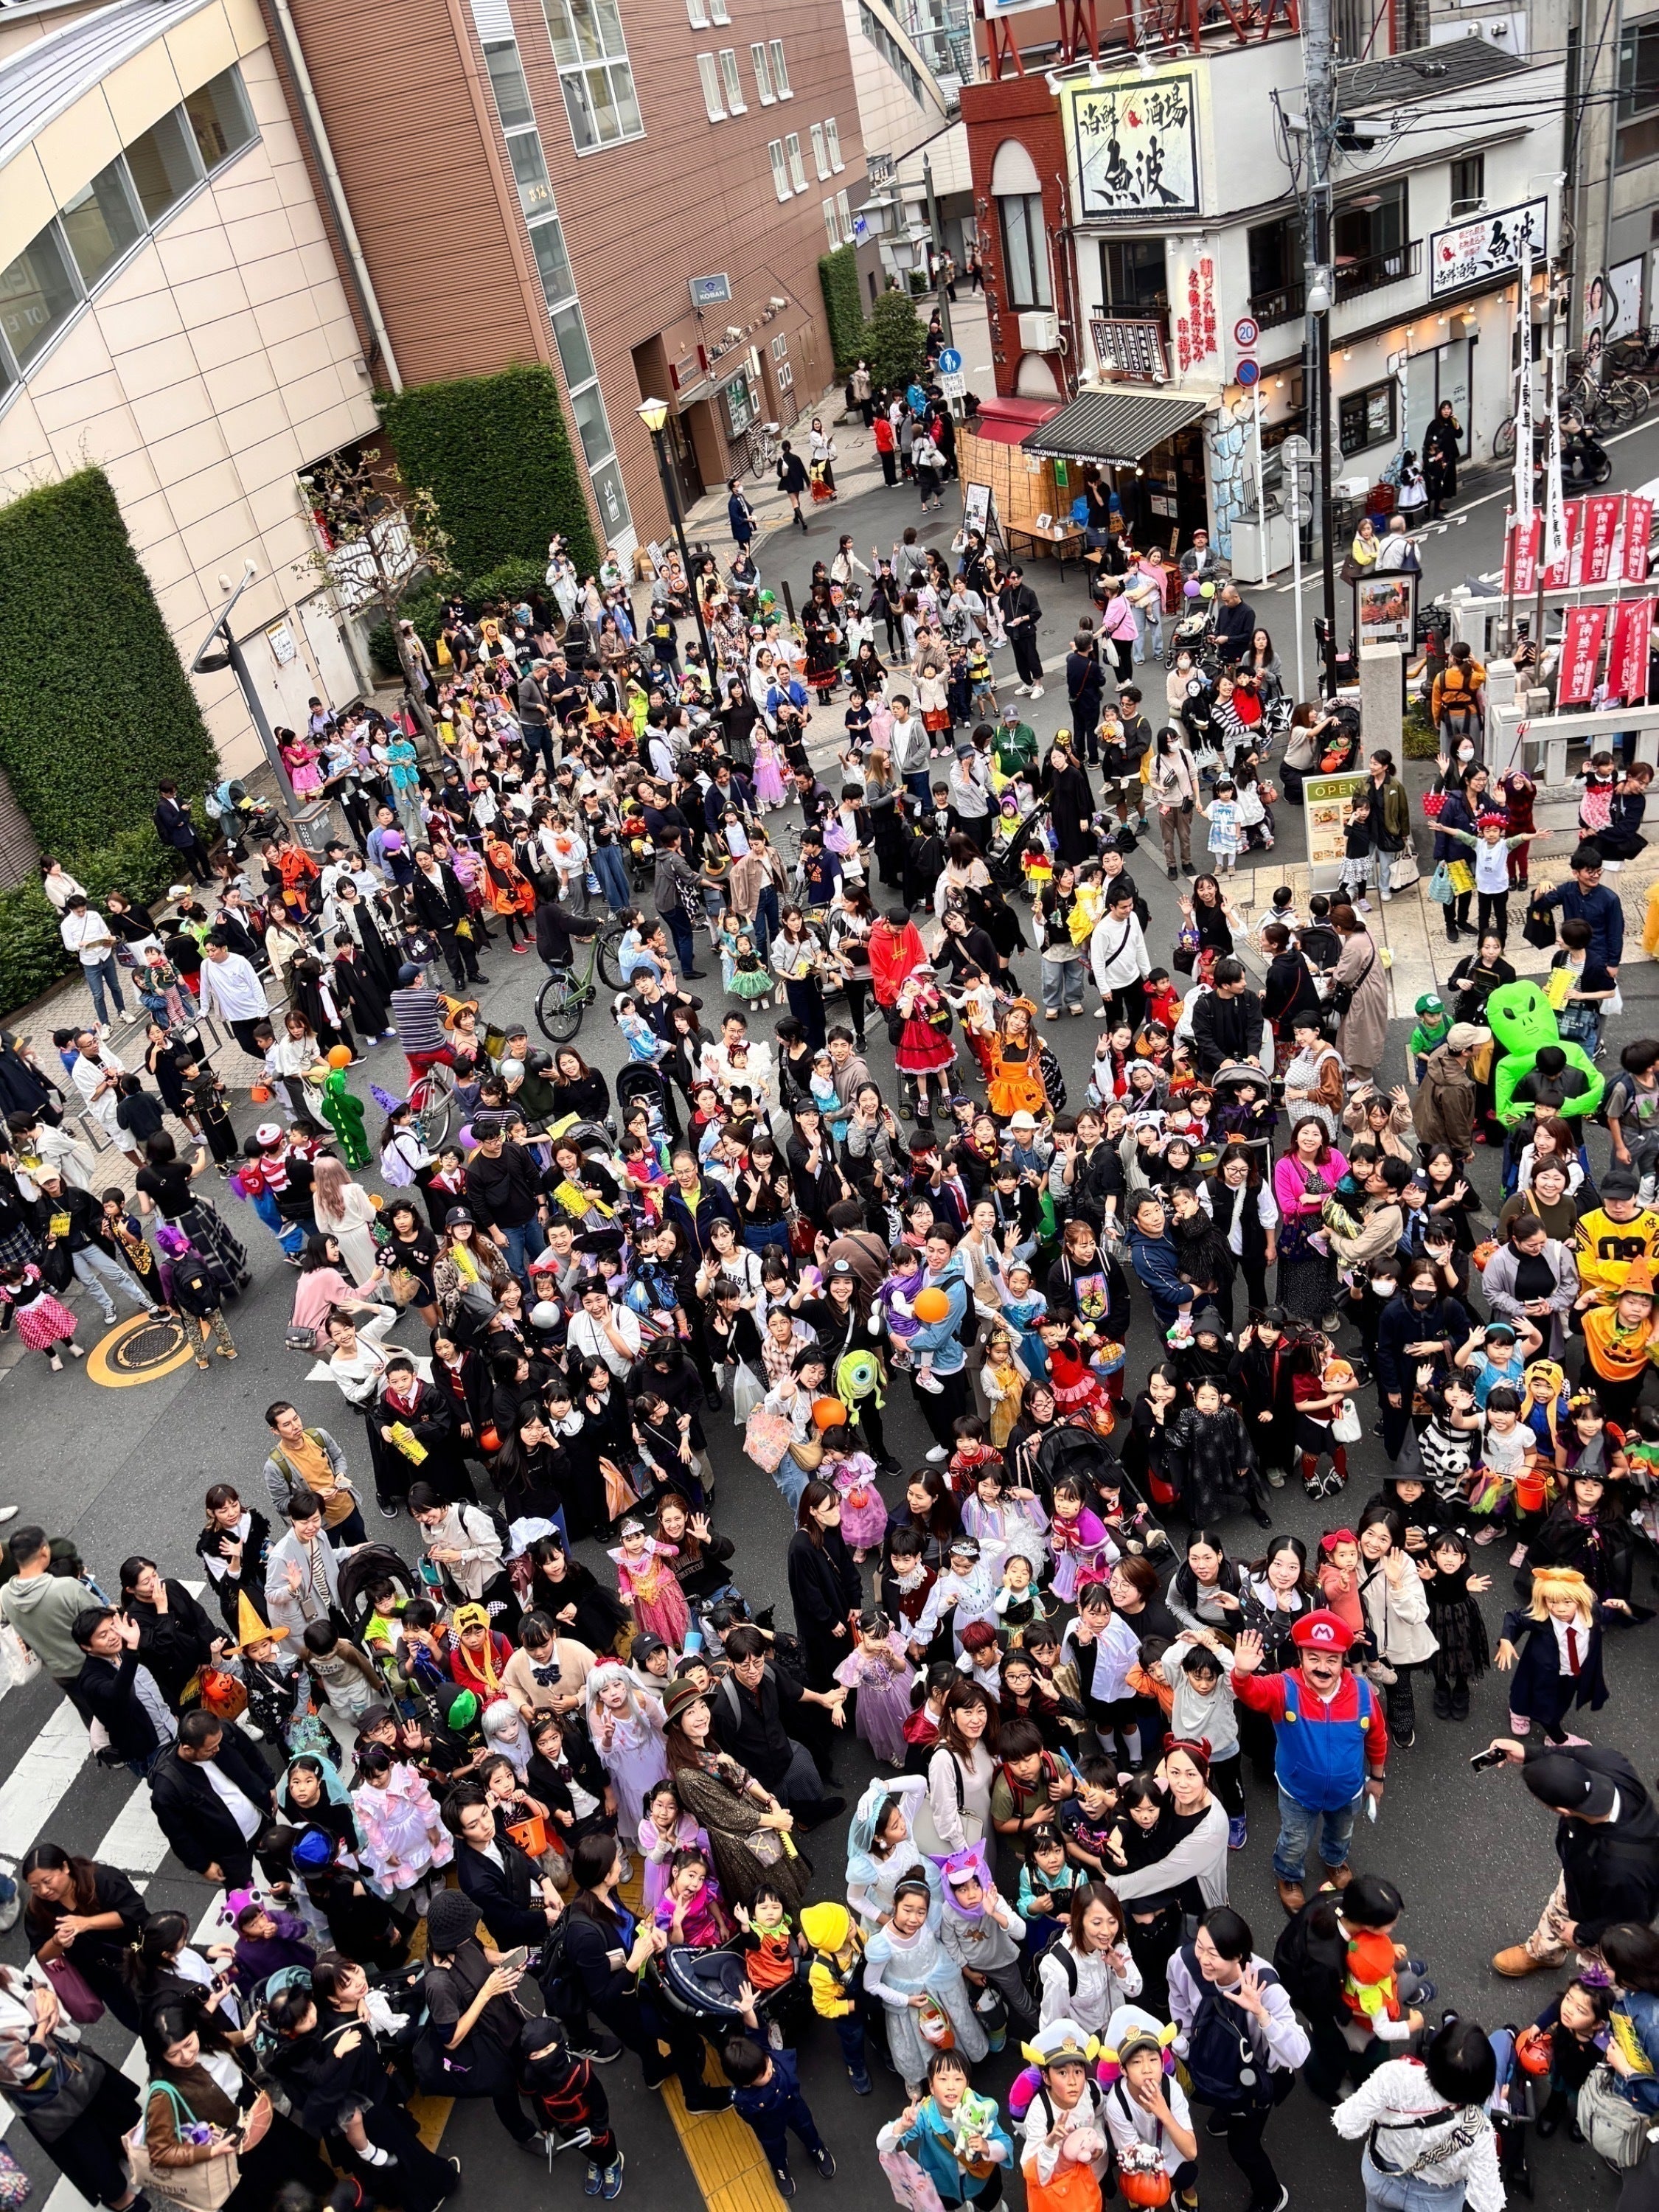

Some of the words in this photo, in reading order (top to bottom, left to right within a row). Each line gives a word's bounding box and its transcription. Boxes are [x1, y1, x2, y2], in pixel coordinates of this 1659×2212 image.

[1079, 91, 1119, 139] 海鮮
[1144, 80, 1188, 131] 酒場
[1091, 136, 1185, 206] 魚波
[1476, 211, 1544, 270] 魚波
[700, 290, 725, 300] KOBAN
[1189, 268, 1206, 363] 名物煮込み
[1200, 258, 1217, 352] 朝どれ鮮魚
[1177, 317, 1192, 372] 串揚げ
[1239, 327, 1253, 340] 20
[1038, 449, 1059, 458] UONAMI
[1075, 454, 1097, 463] UONAMI
[1315, 783, 1357, 796] OPEN
[1314, 1627, 1331, 1639] M
